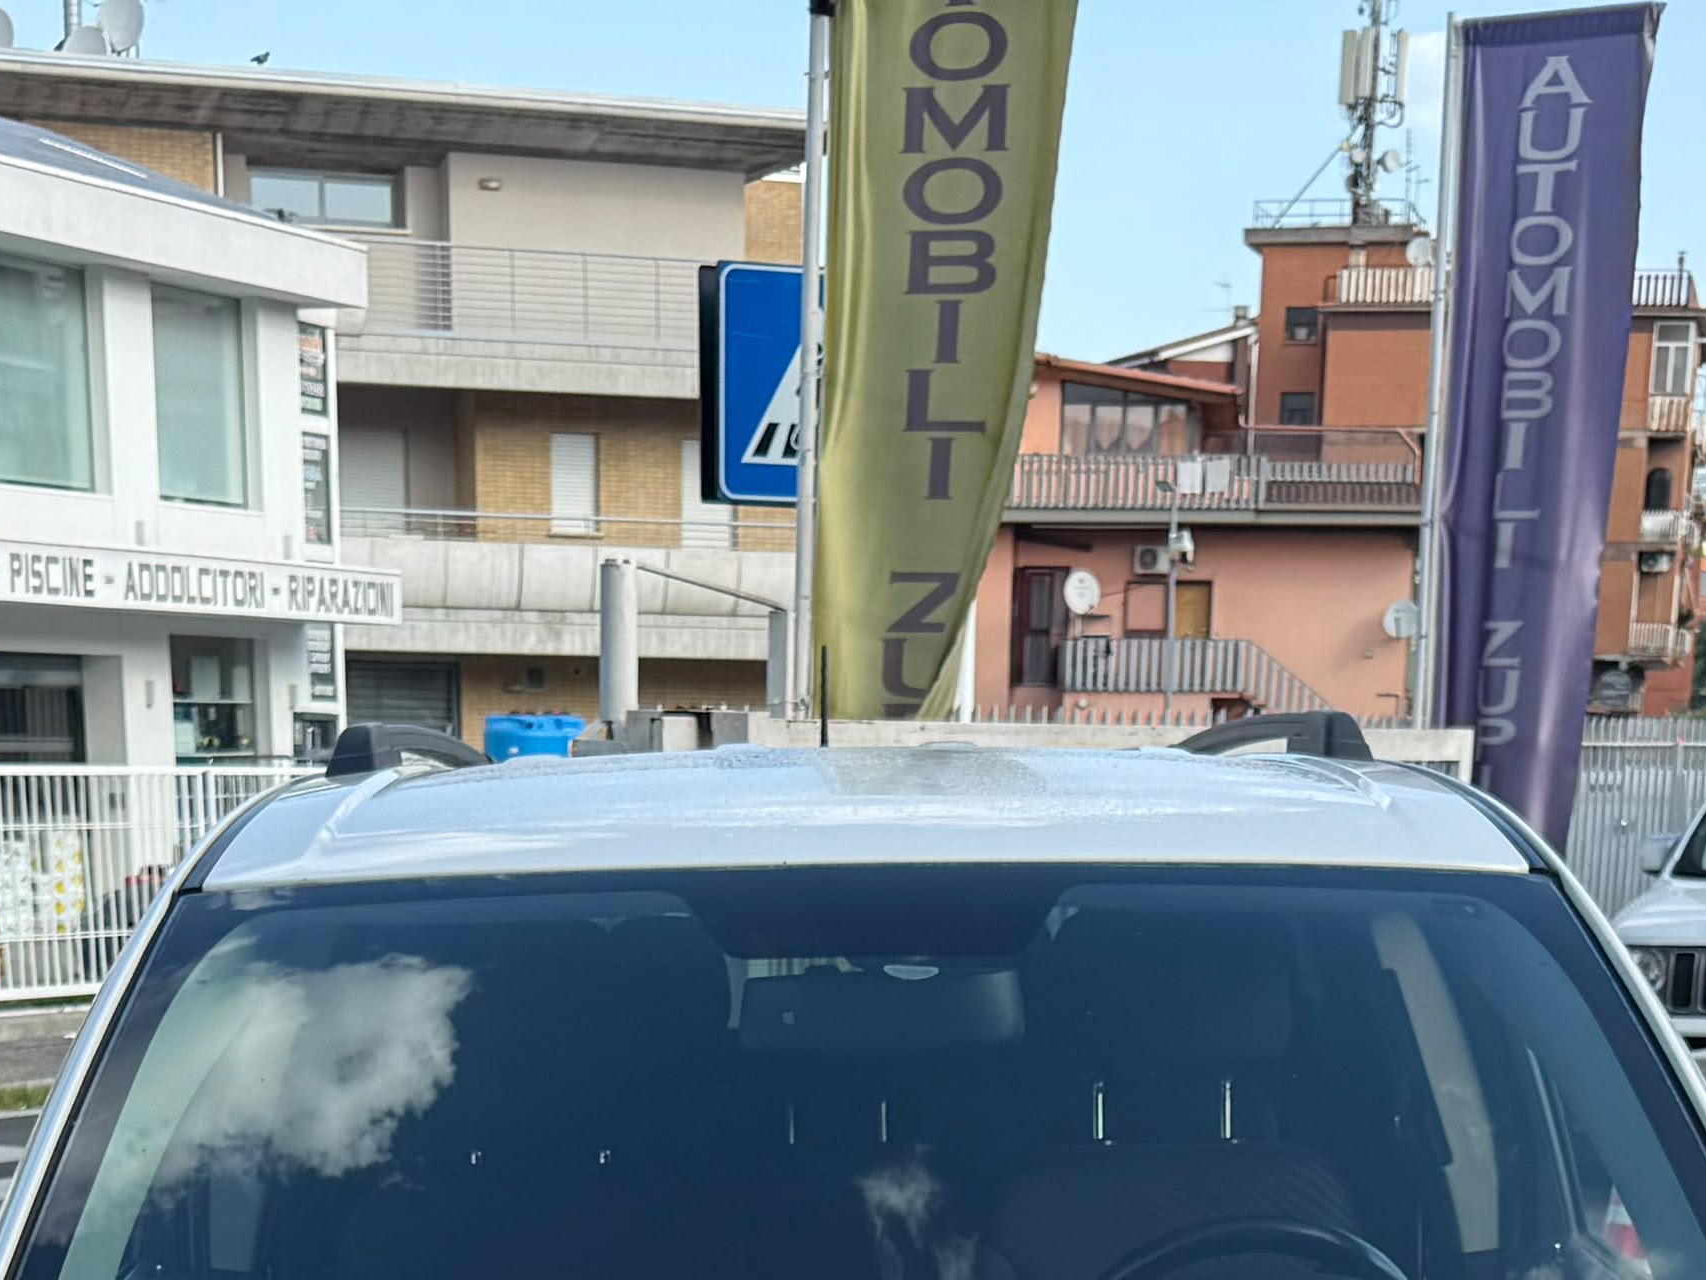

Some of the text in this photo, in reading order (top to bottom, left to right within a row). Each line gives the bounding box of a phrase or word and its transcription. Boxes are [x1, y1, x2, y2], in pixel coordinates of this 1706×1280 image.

[899, 0, 1011, 500] OMOBILI
[1492, 55, 1593, 568] AUTOMOBILI
[9, 552, 95, 598] PISCINE
[124, 561, 266, 609] ADDOLCITORI
[287, 574, 394, 618] RIPARAZIONI
